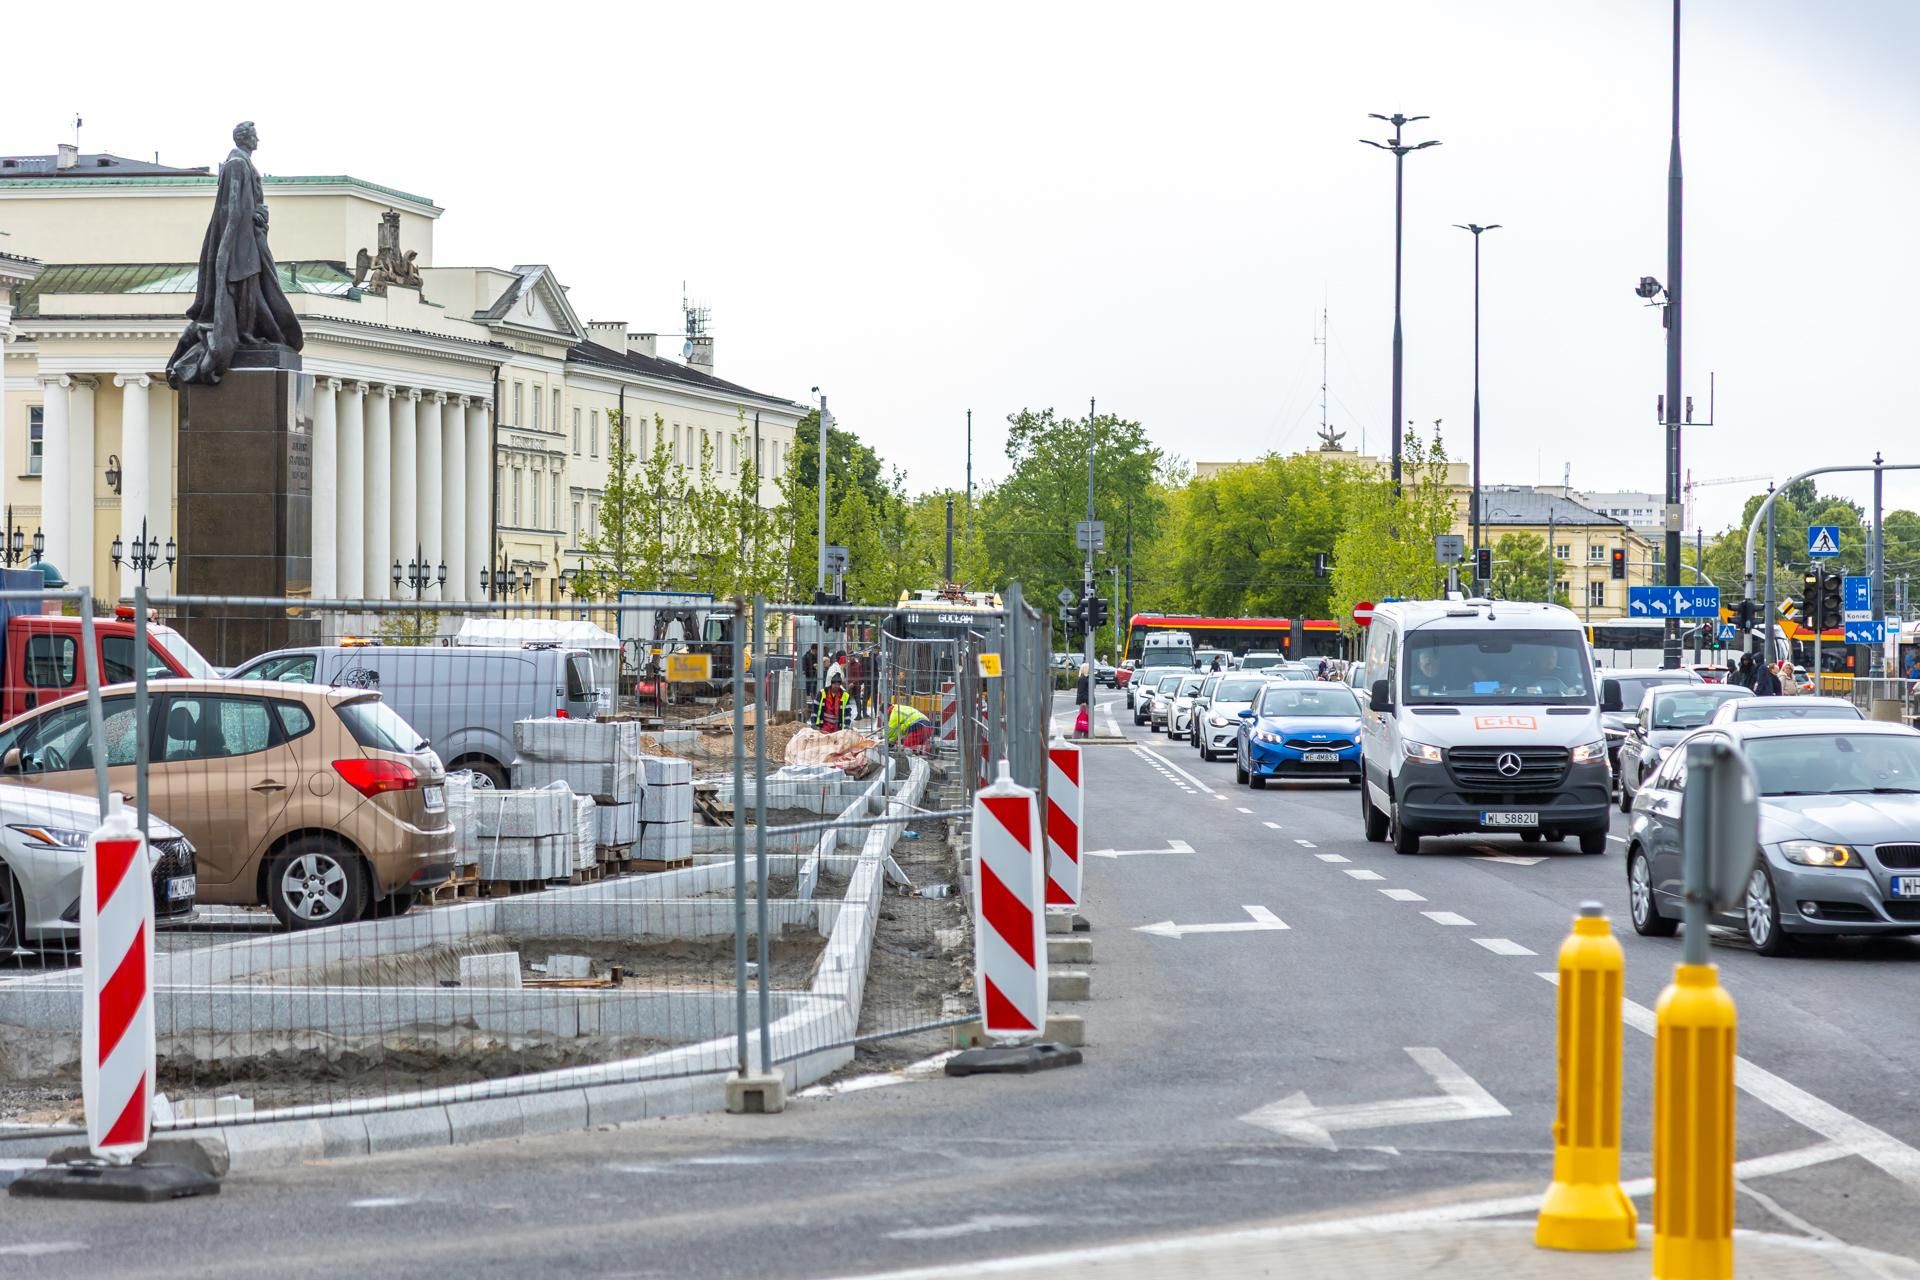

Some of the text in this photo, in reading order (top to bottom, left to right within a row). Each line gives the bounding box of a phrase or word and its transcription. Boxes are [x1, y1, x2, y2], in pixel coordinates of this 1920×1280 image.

[1696, 597, 1717, 608] BUS
[1488, 813, 1537, 824] WL 5882U
